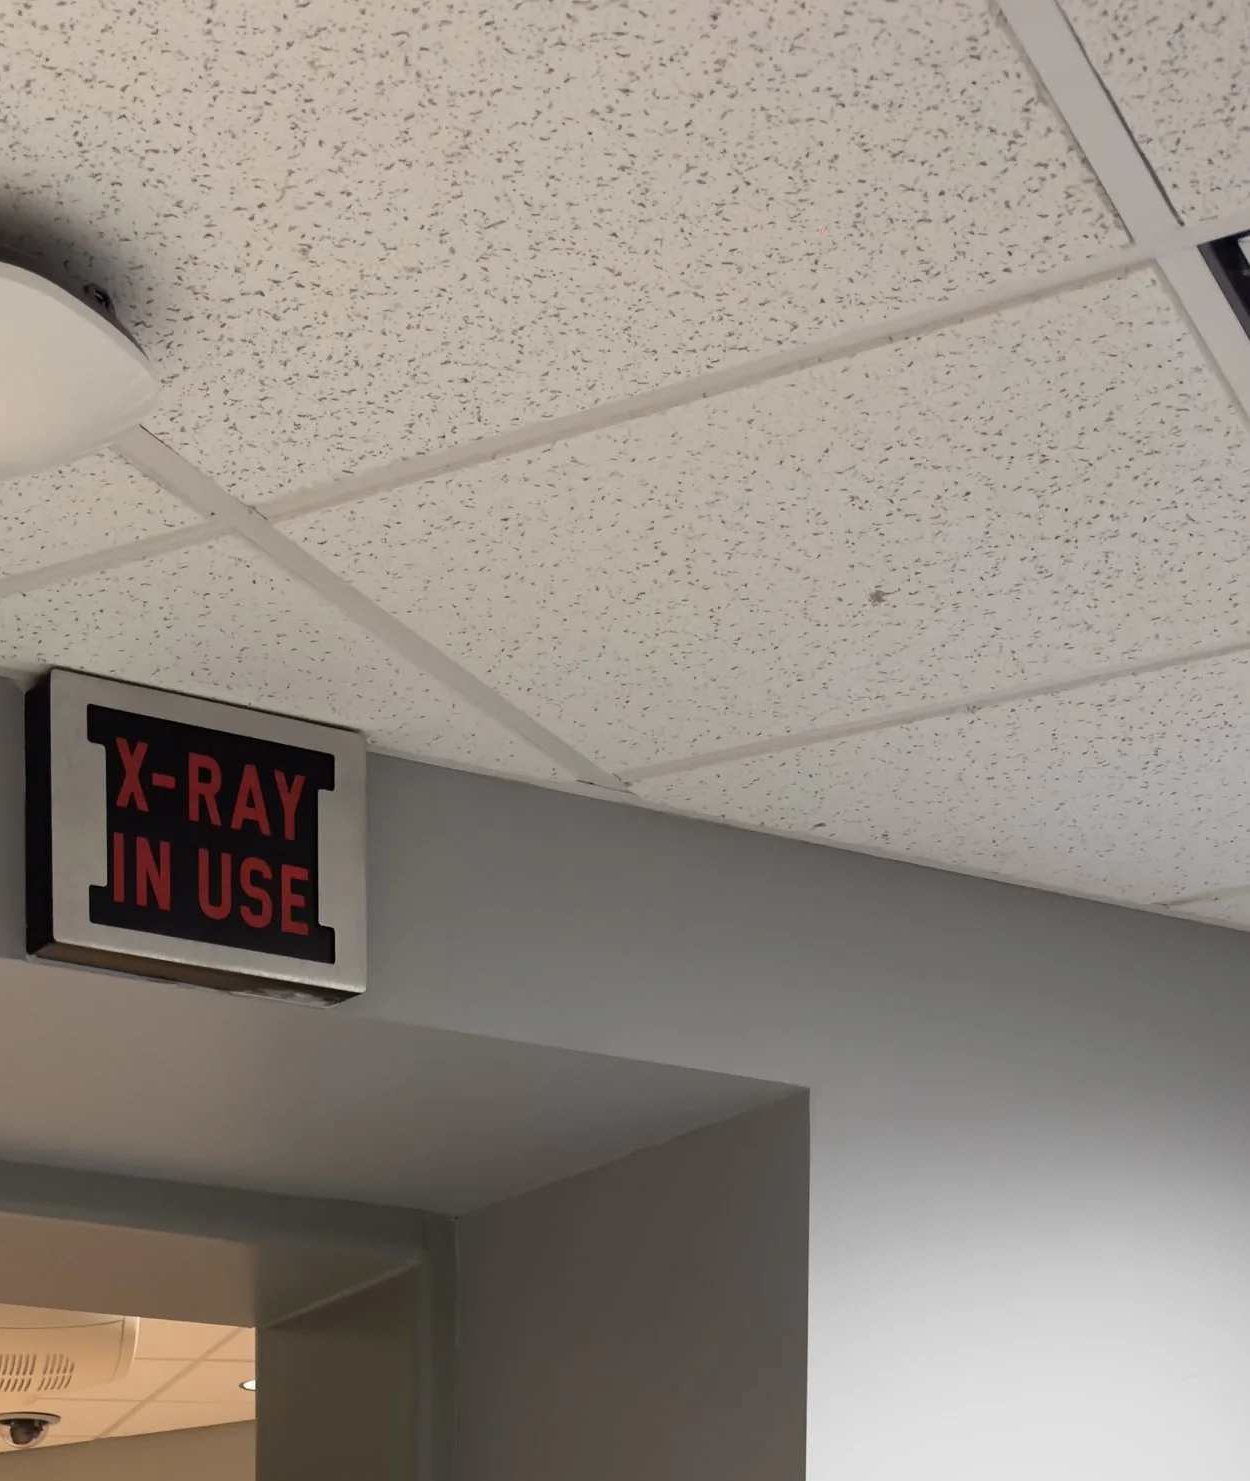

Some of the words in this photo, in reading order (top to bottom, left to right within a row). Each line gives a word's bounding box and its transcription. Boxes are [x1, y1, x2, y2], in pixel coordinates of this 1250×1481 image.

[115, 735, 306, 842] X-RAY
[112, 831, 172, 912] IN
[199, 847, 310, 937] USE
